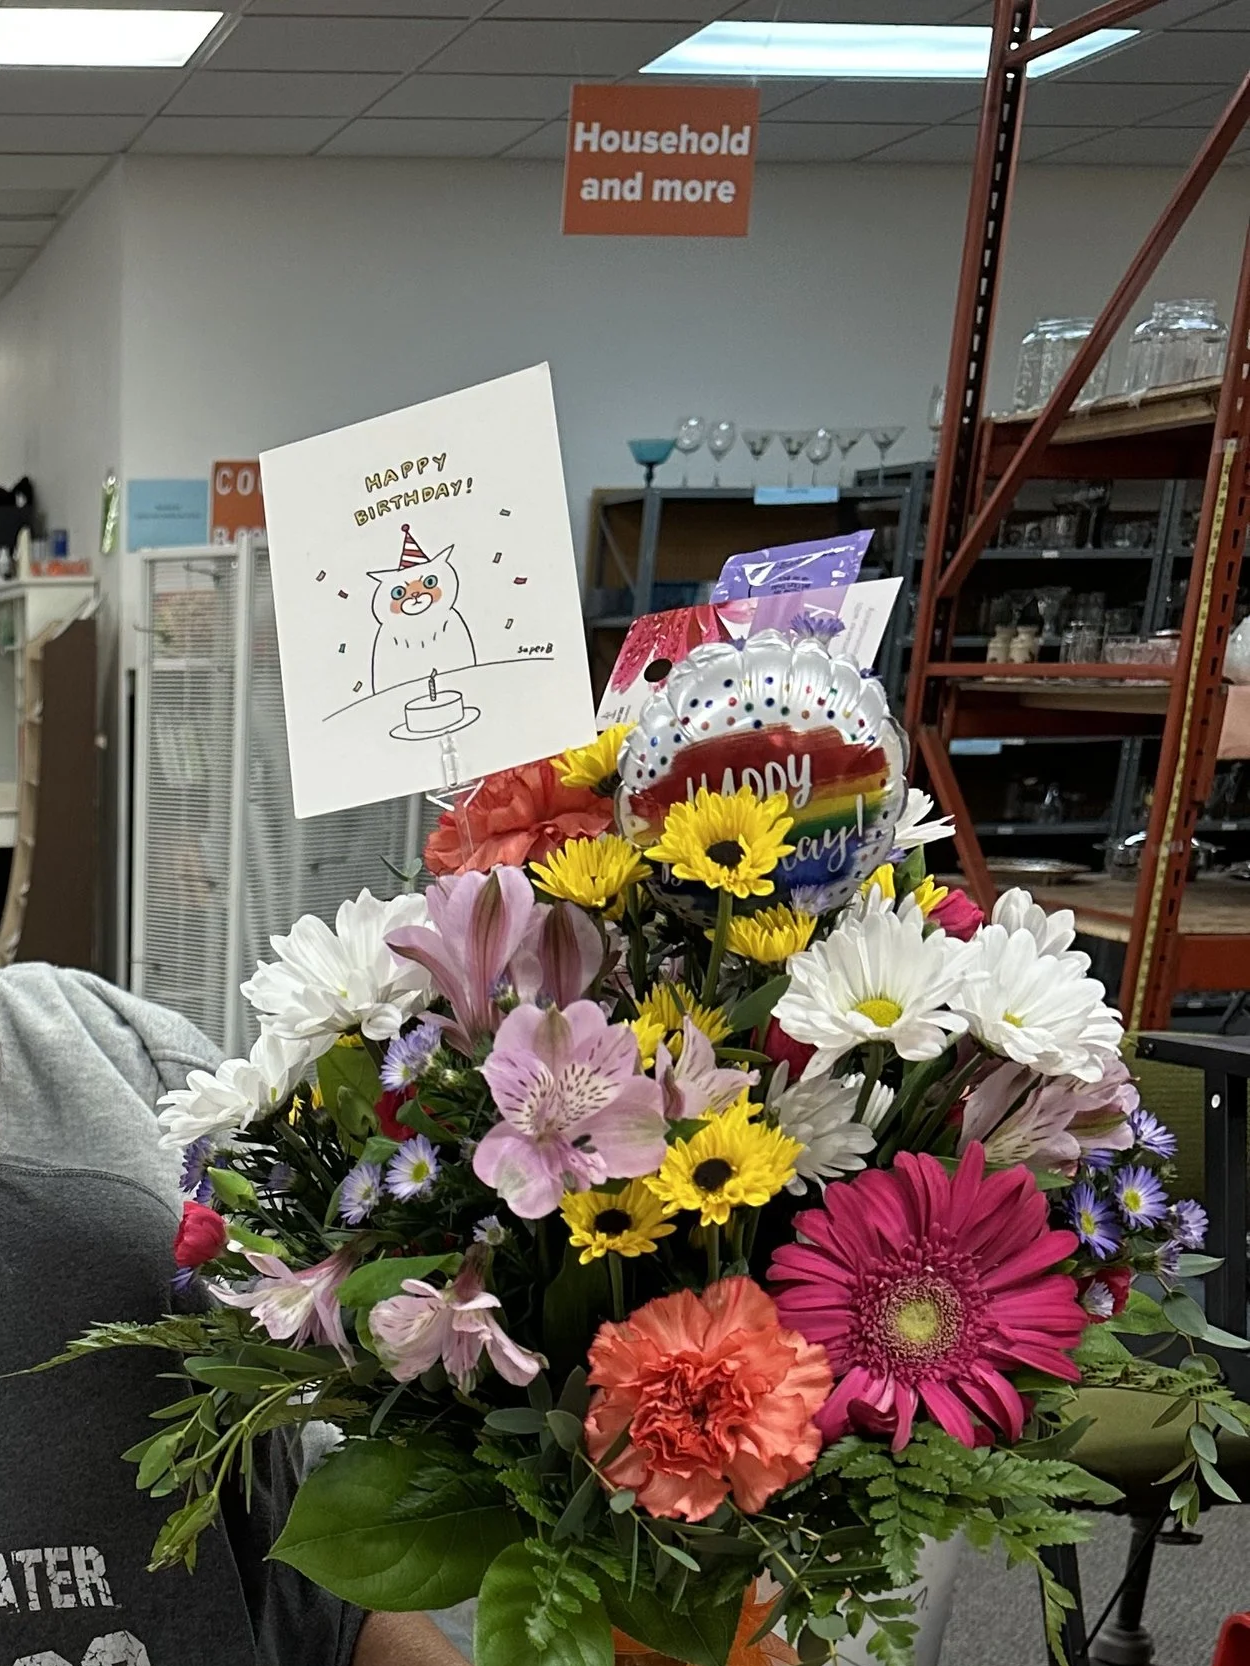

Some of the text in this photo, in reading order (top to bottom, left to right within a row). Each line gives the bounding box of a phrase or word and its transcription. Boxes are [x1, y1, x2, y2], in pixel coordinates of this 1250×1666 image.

[573, 121, 751, 156] Household
[579, 171, 737, 203] and more
[216, 466, 264, 496] CO
[365, 453, 447, 493] HAPPY
[353, 477, 473, 526] BIRTHDAY!
